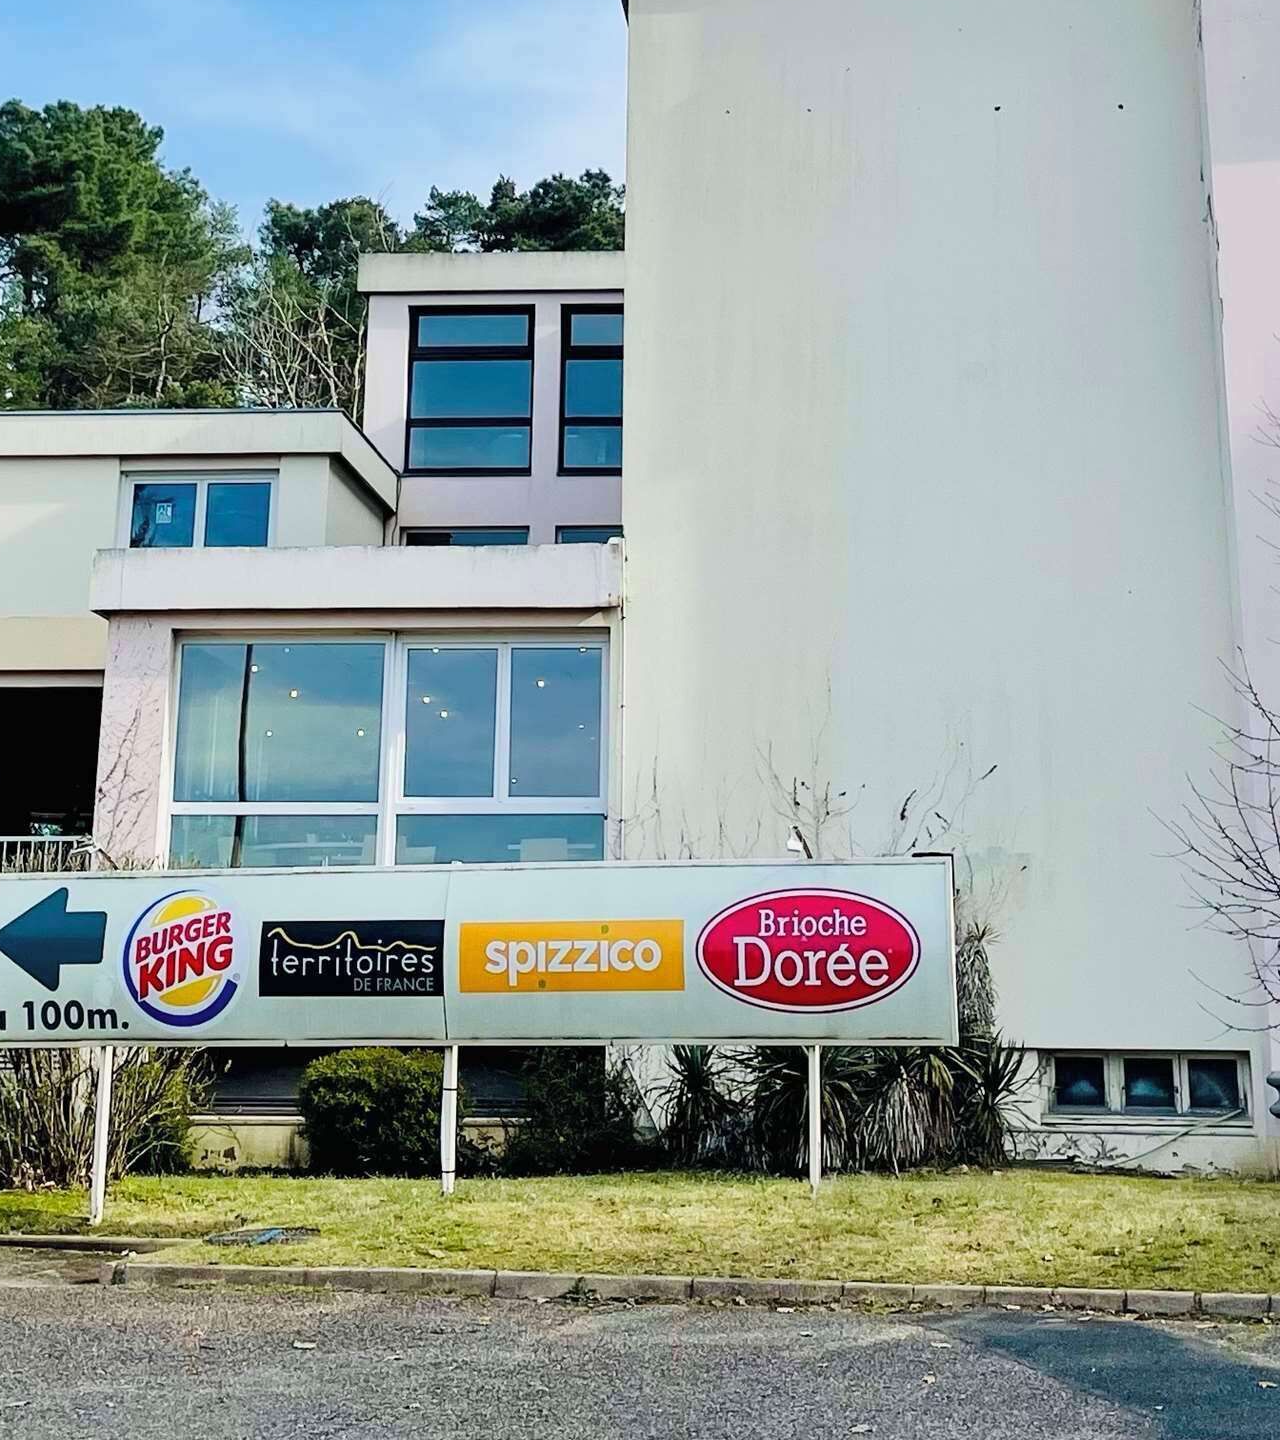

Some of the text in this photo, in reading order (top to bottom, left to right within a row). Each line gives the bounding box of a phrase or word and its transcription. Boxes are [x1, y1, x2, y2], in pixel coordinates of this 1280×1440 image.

[134, 911, 232, 966] BURGER
[758, 908, 867, 937] Brioche
[137, 935, 234, 1000] KING
[271, 938, 434, 976] territoires
[485, 938, 662, 987] spizzico
[733, 936, 889, 987] Dorée
[353, 976, 434, 992] DE FRANCE
[21, 1000, 129, 1031] 100m.
